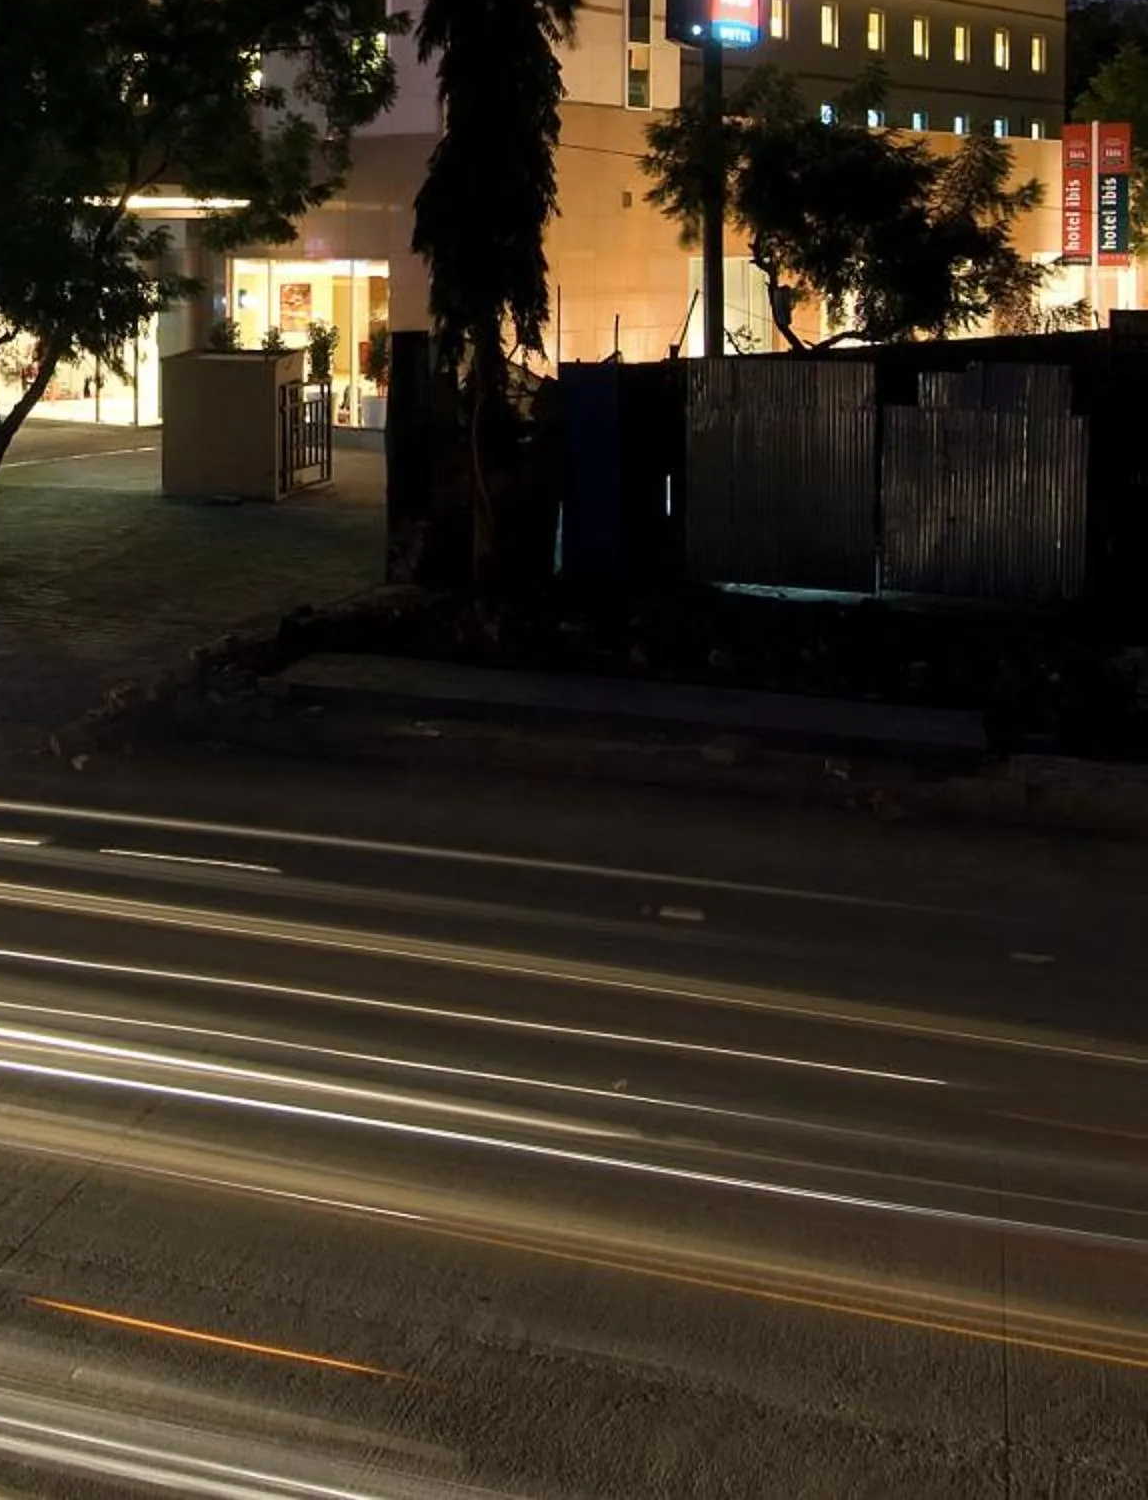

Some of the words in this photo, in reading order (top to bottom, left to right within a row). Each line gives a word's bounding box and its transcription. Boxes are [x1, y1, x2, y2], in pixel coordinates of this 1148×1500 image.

[1065, 179, 1081, 207] ibis
[1101, 177, 1117, 205] ibis
[1064, 212, 1081, 251] hotel
[1101, 211, 1117, 250] hotel
